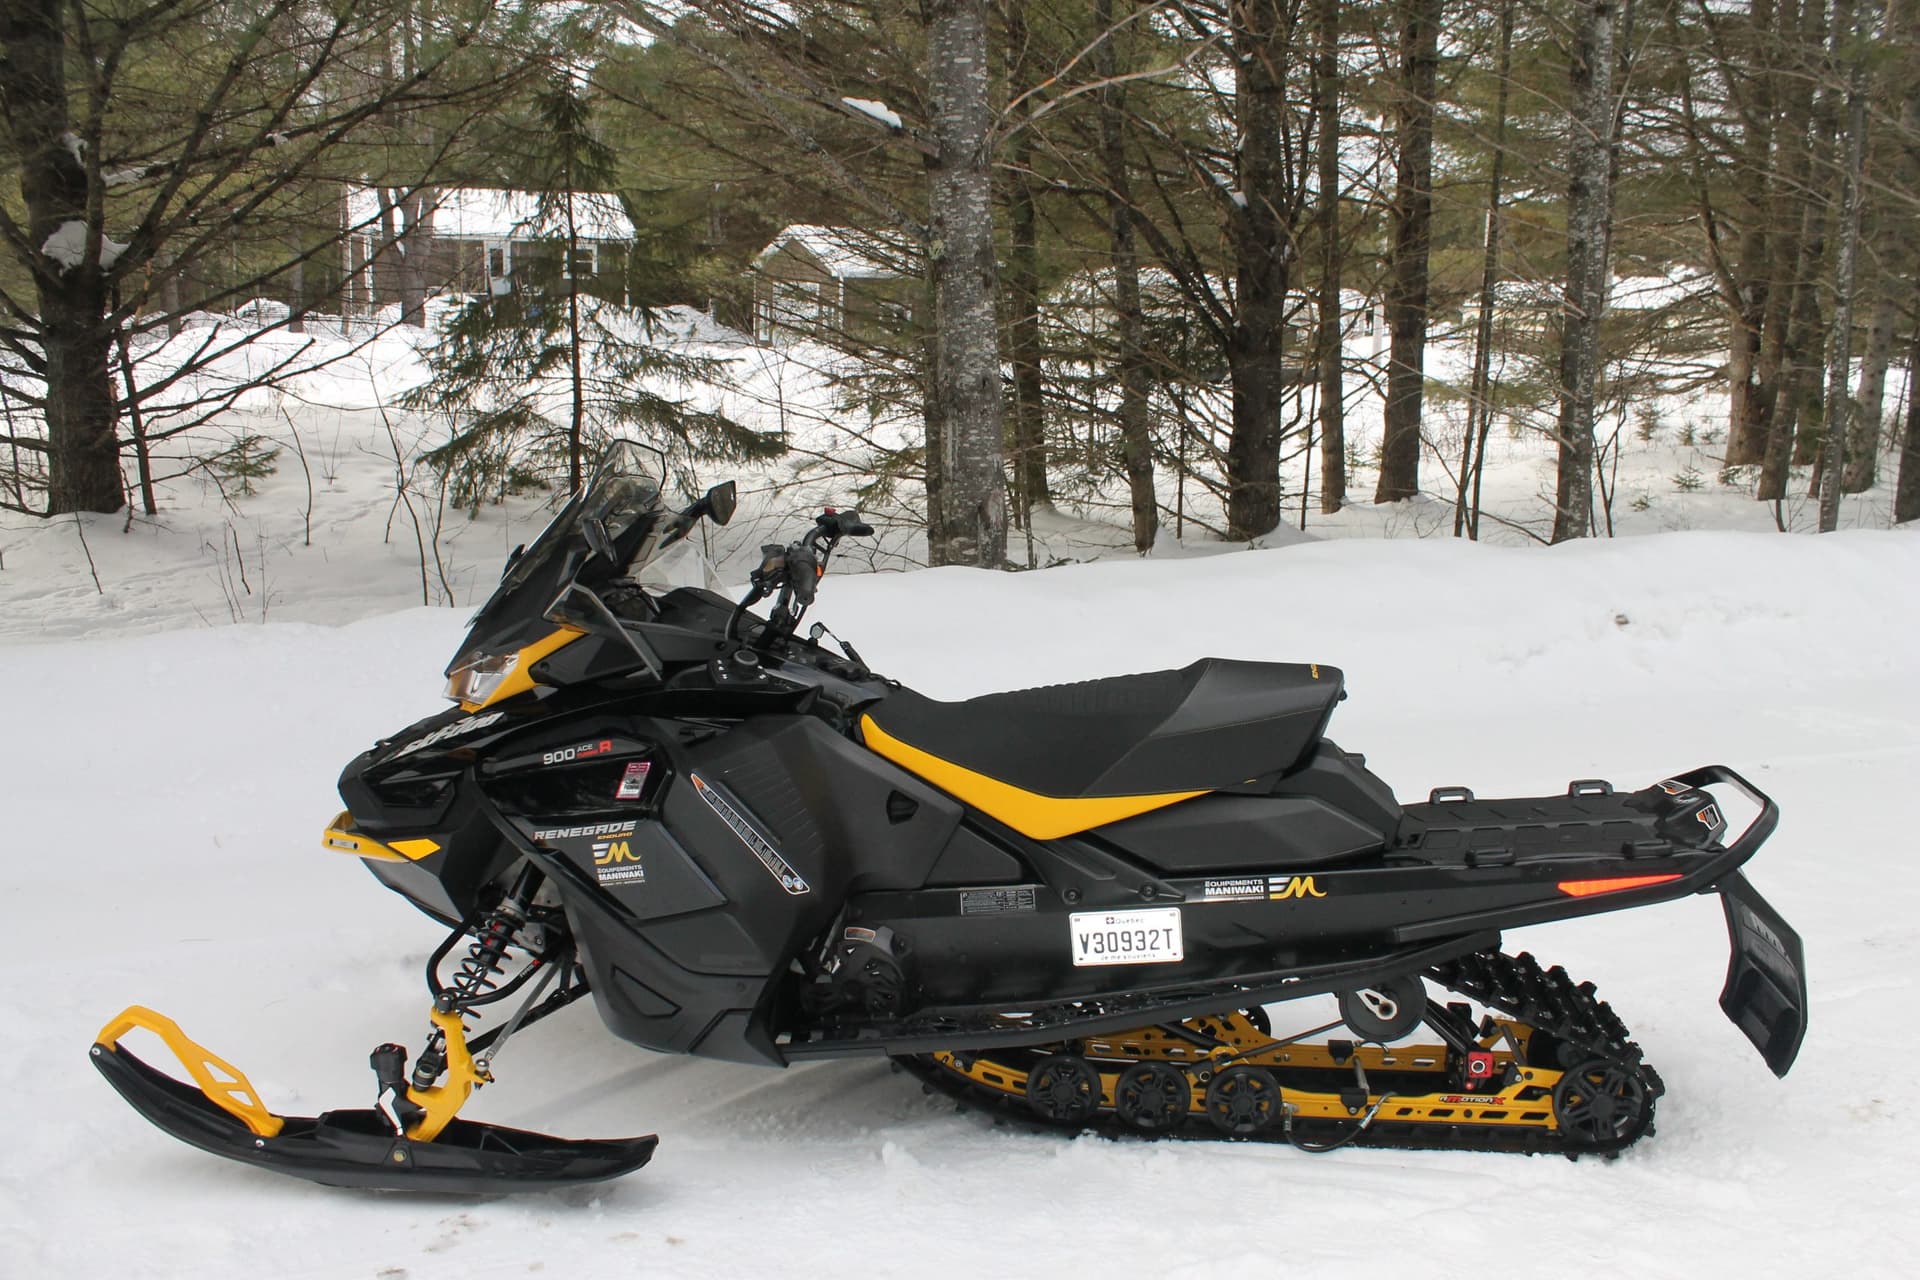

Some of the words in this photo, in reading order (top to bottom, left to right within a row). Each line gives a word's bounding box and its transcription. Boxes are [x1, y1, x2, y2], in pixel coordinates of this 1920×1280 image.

[543, 748, 576, 765] 900
[577, 743, 593, 752] ACE
[534, 820, 638, 840] RENEGADE
[598, 869, 645, 881] MANIWAKI
[1205, 885, 1265, 895] MANIWAKI
[1079, 928, 1174, 955] V30932T
